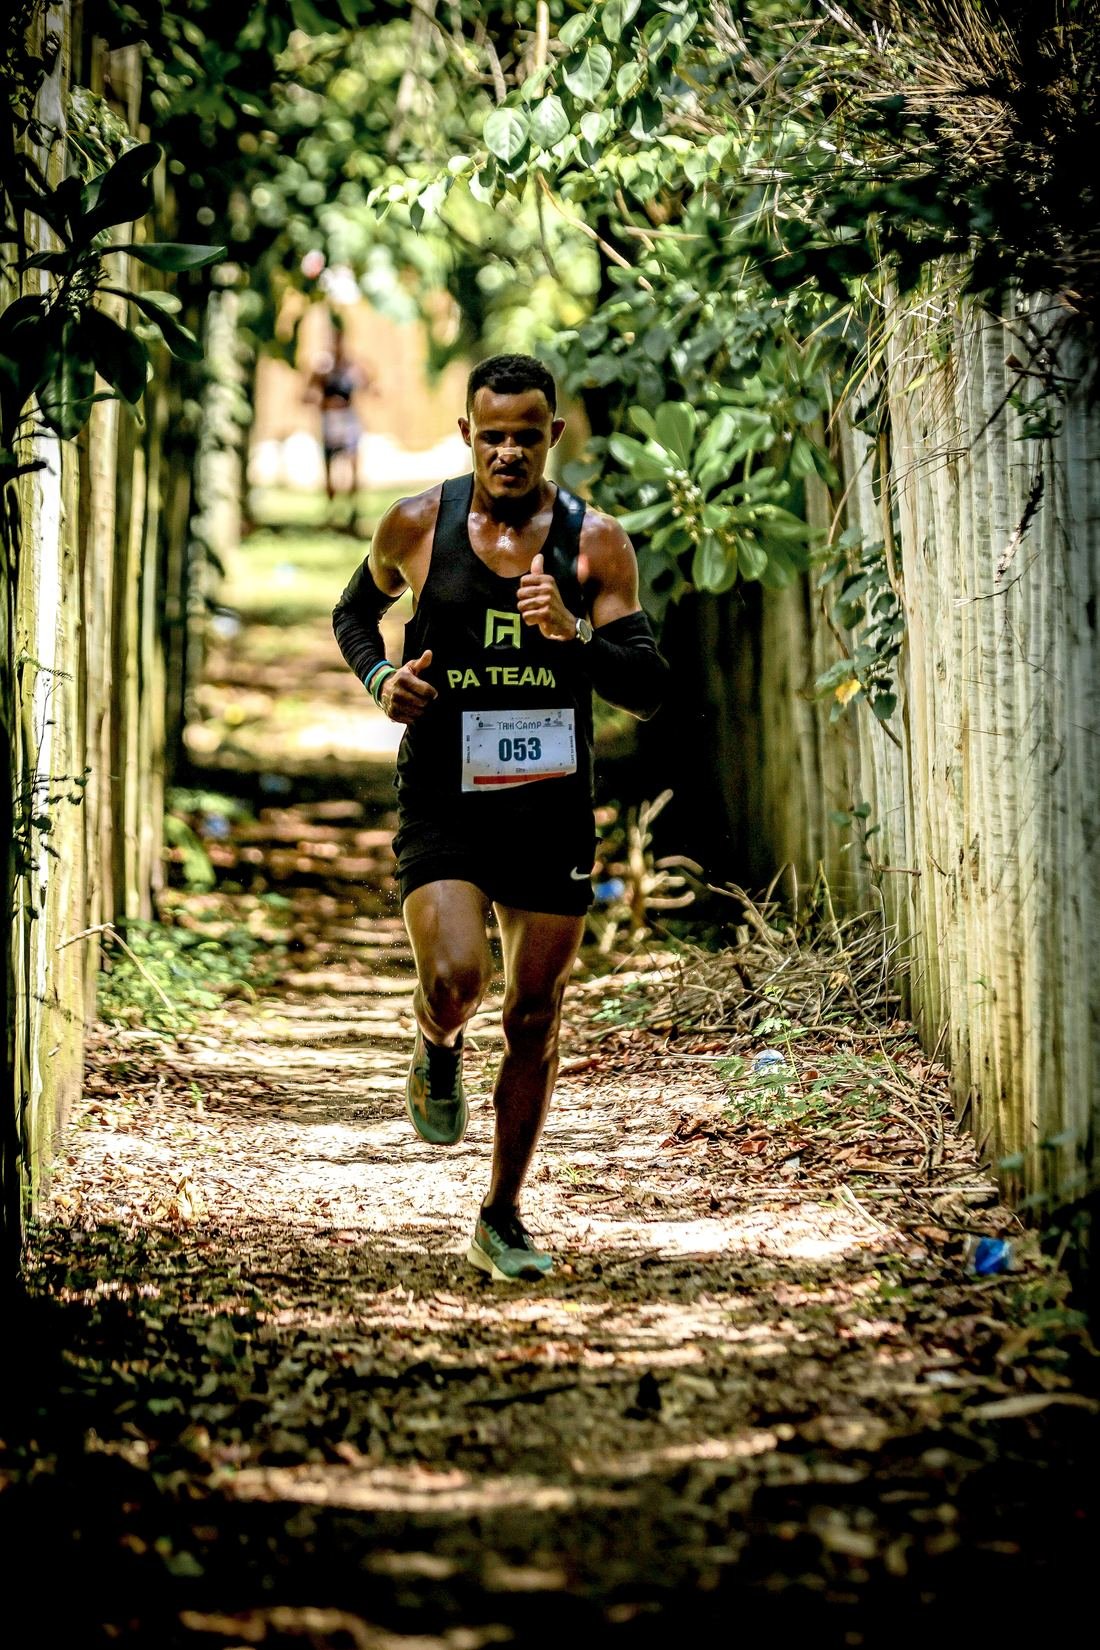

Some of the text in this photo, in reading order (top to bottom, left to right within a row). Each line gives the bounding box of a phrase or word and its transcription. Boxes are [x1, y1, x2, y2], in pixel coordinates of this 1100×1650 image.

[447, 666, 556, 688] PA TEAM
[498, 737, 542, 762] 053
